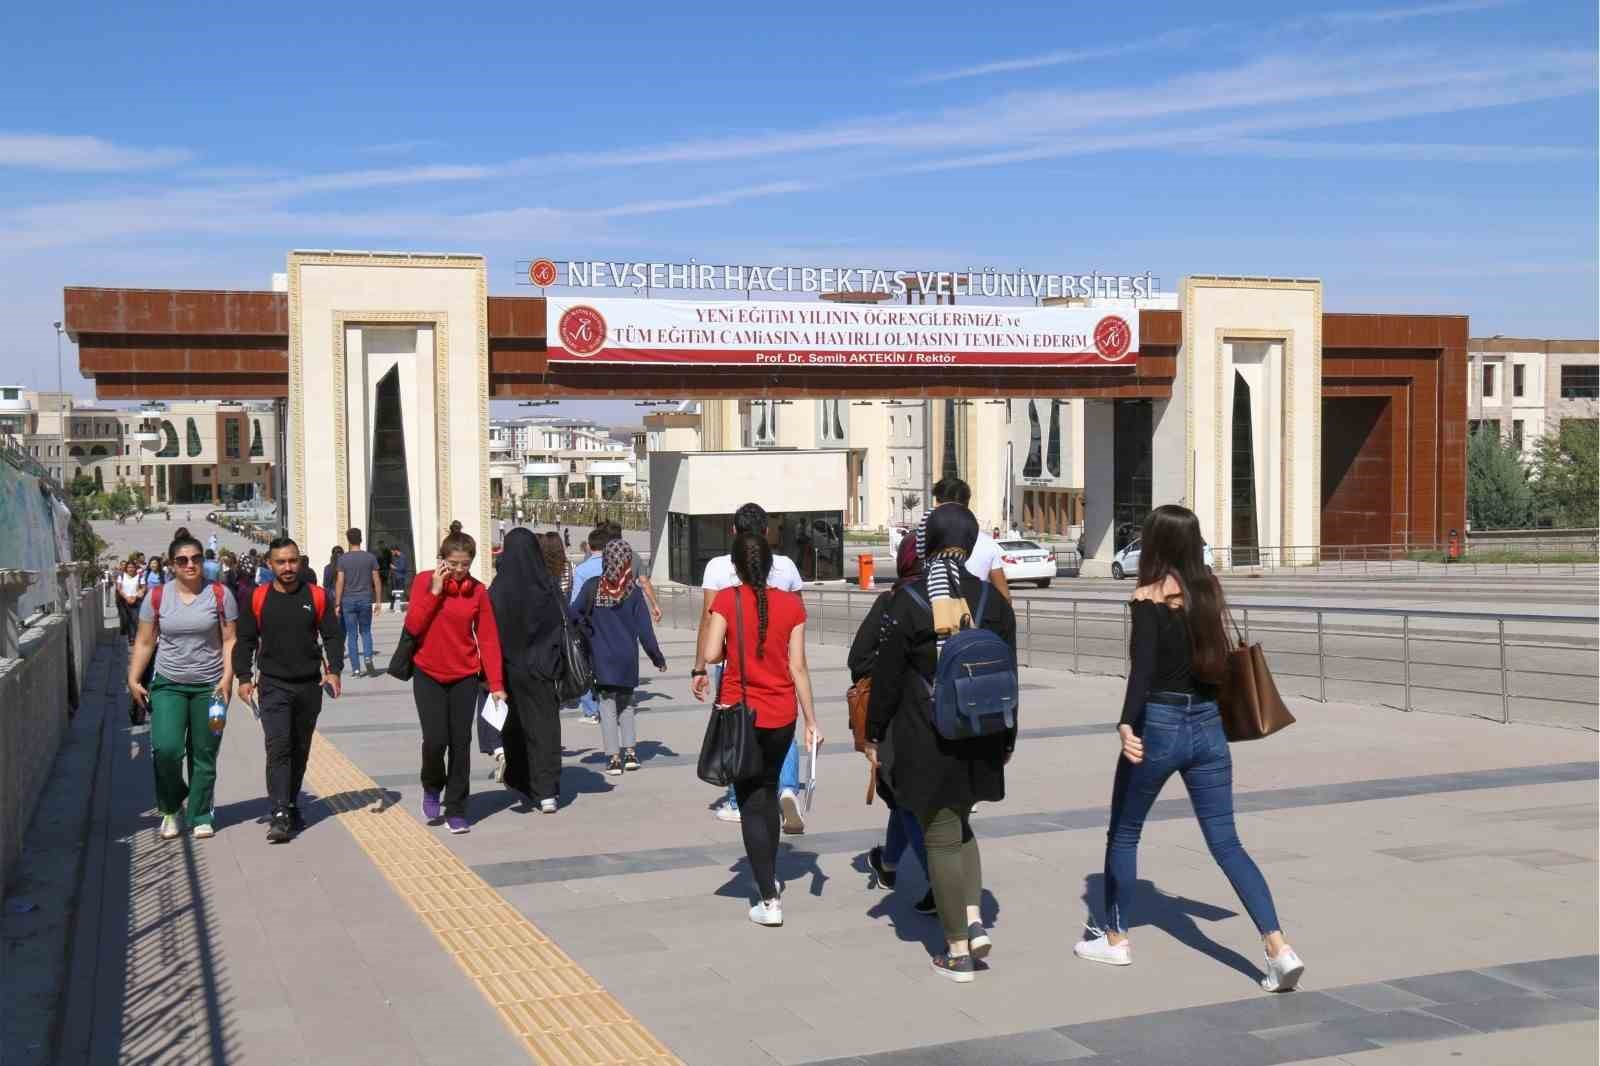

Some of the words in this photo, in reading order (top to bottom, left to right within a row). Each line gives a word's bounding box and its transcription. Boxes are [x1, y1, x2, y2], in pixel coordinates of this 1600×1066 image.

[568, 257, 715, 295] NEVŞEHİR
[724, 265, 793, 291] HACI
[802, 268, 907, 299] BEKTAŞ
[916, 266, 973, 296] VELİ
[982, 267, 1152, 299] ÜNİVERSİTESİ
[799, 310, 859, 325] YILININ
[1007, 317, 1020, 327] ve
[615, 325, 651, 343] TÜM
[815, 330, 879, 346] HAYIRLI
[884, 331, 958, 347] OLMASINI
[755, 353, 784, 363] Prof.
[788, 353, 805, 363] Dr.
[809, 353, 846, 363] Semih
[849, 352, 905, 363] AKTEKİN
[908, 353, 914, 363] /
[916, 353, 956, 363] Rektör
